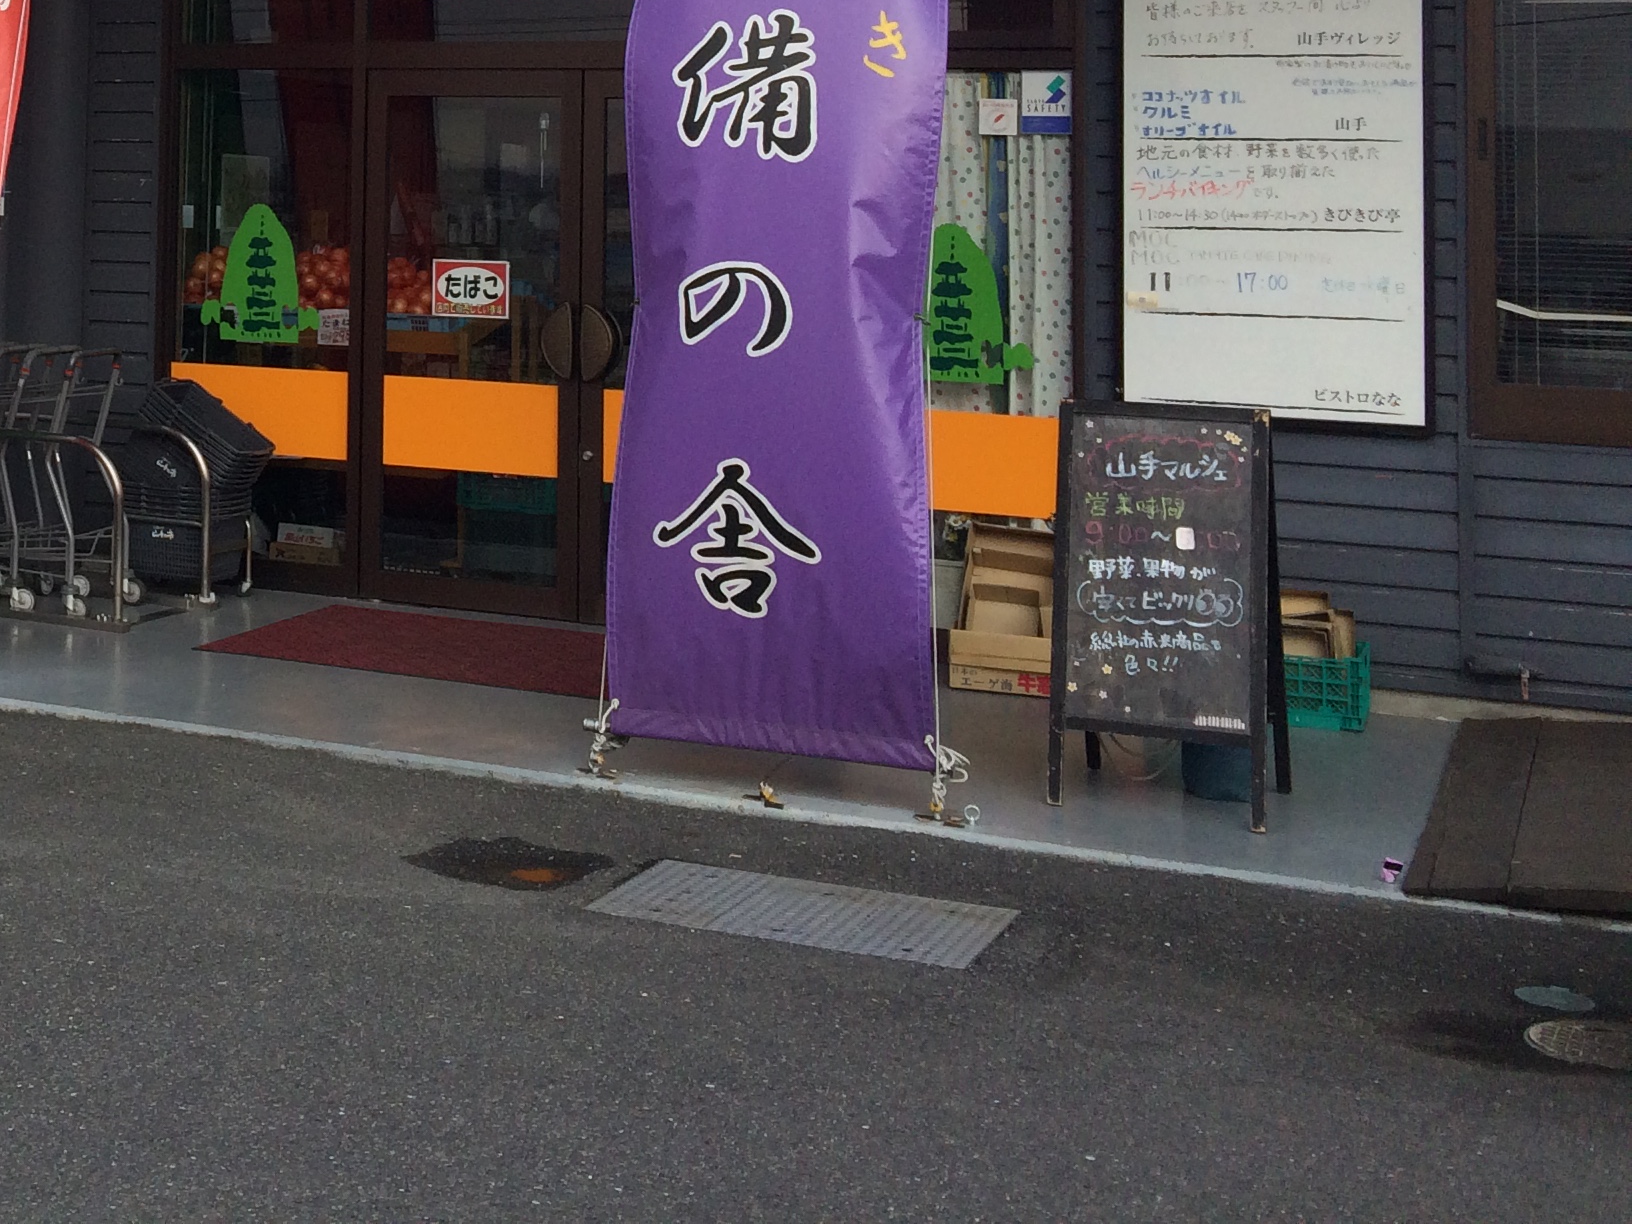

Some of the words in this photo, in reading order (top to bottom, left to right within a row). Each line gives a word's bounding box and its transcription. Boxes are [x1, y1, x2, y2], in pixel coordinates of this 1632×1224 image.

[1297, 30, 1401, 47] 山手ヴィレッジ
[1027, 103, 1066, 113] SAFETY
[1335, 117, 1367, 131] 山手
[1324, 208, 1401, 223] きびきび亭
[444, 274, 499, 299] たばこ
[1314, 389, 1401, 407] ビストロなな
[1106, 450, 1229, 481] 山手マルシェ
